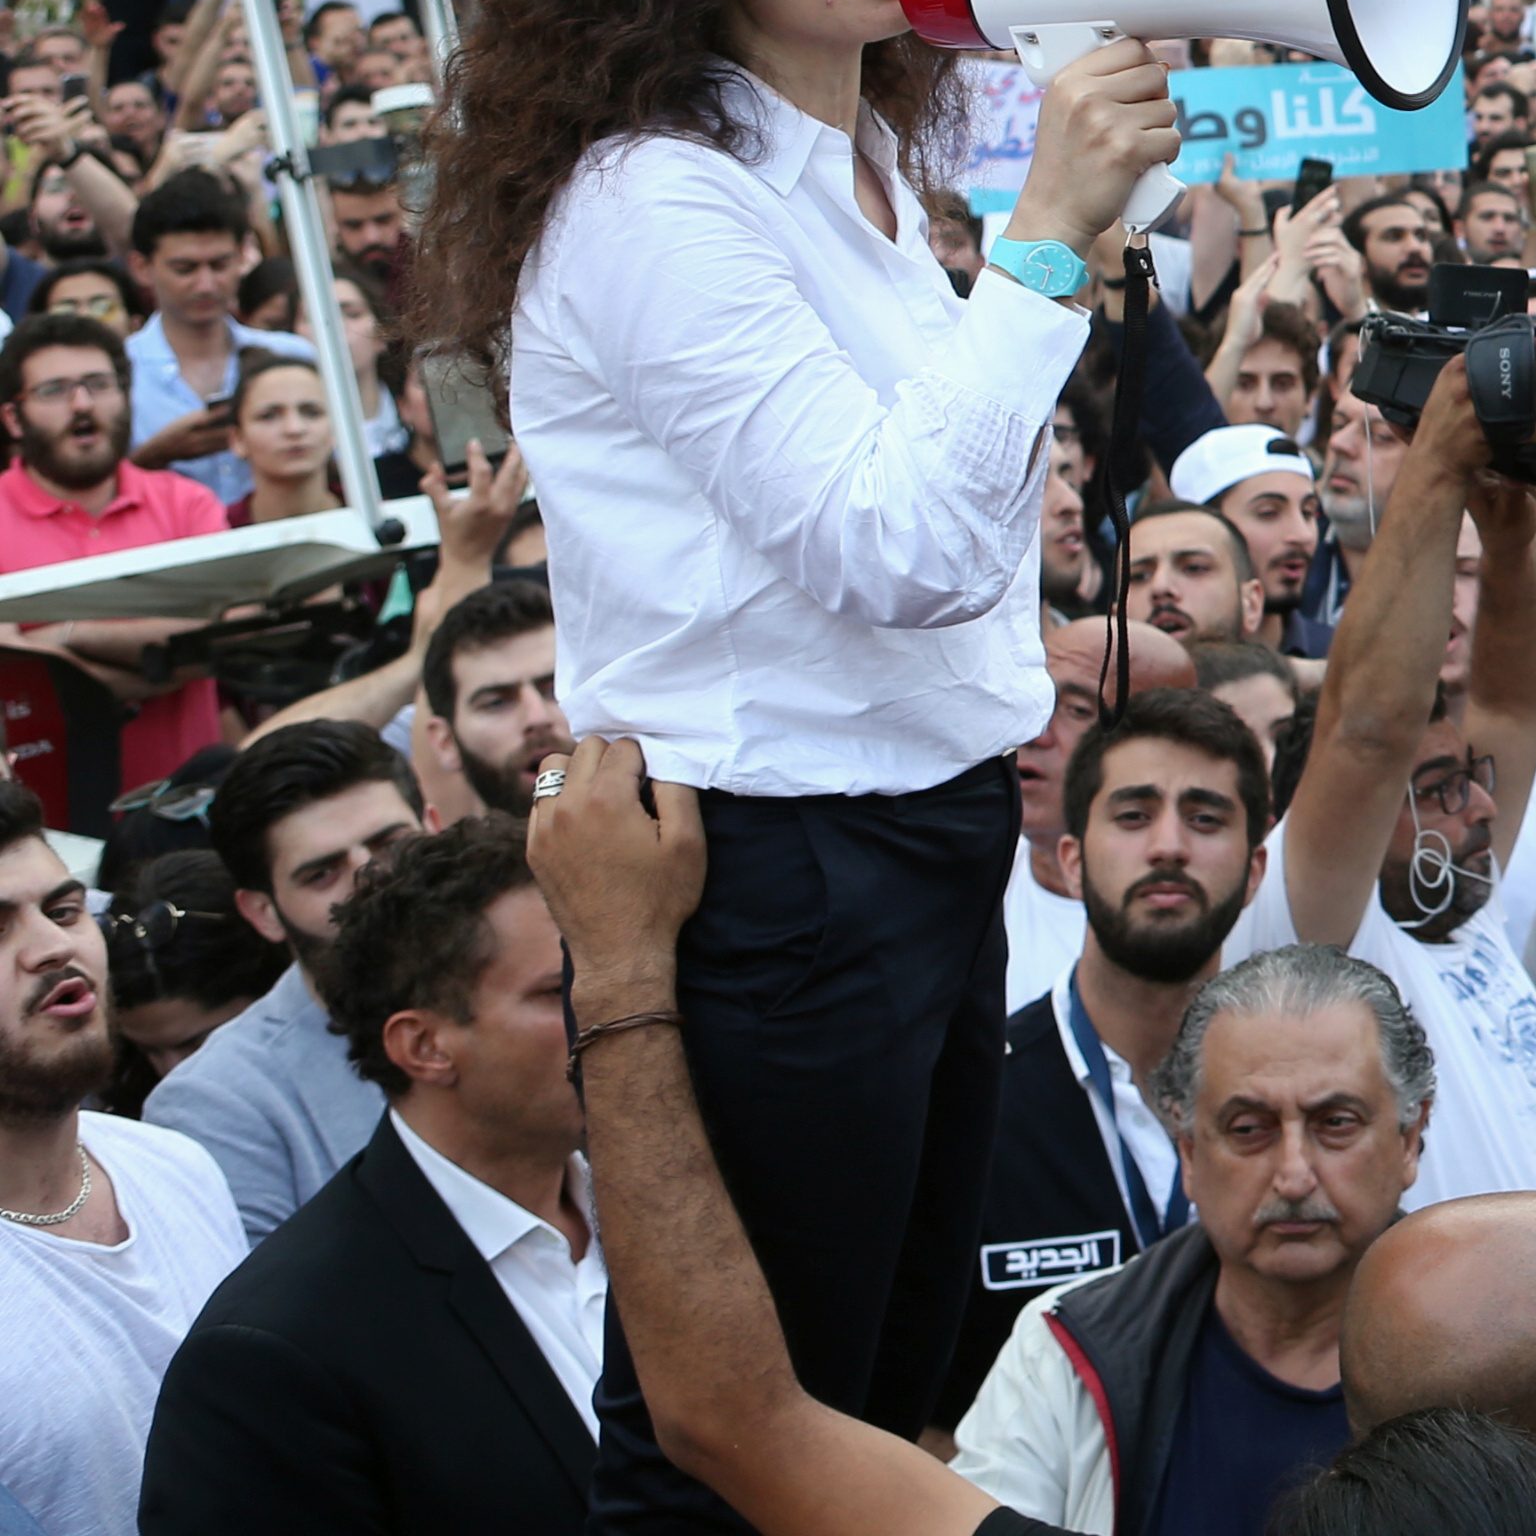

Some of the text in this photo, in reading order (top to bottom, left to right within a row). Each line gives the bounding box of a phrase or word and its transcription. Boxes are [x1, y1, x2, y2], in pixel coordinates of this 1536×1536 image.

[1175, 85, 1376, 149] كلنا وط
[1499, 347, 1512, 399] SONY
[1005, 1240, 1101, 1279] الجديد
